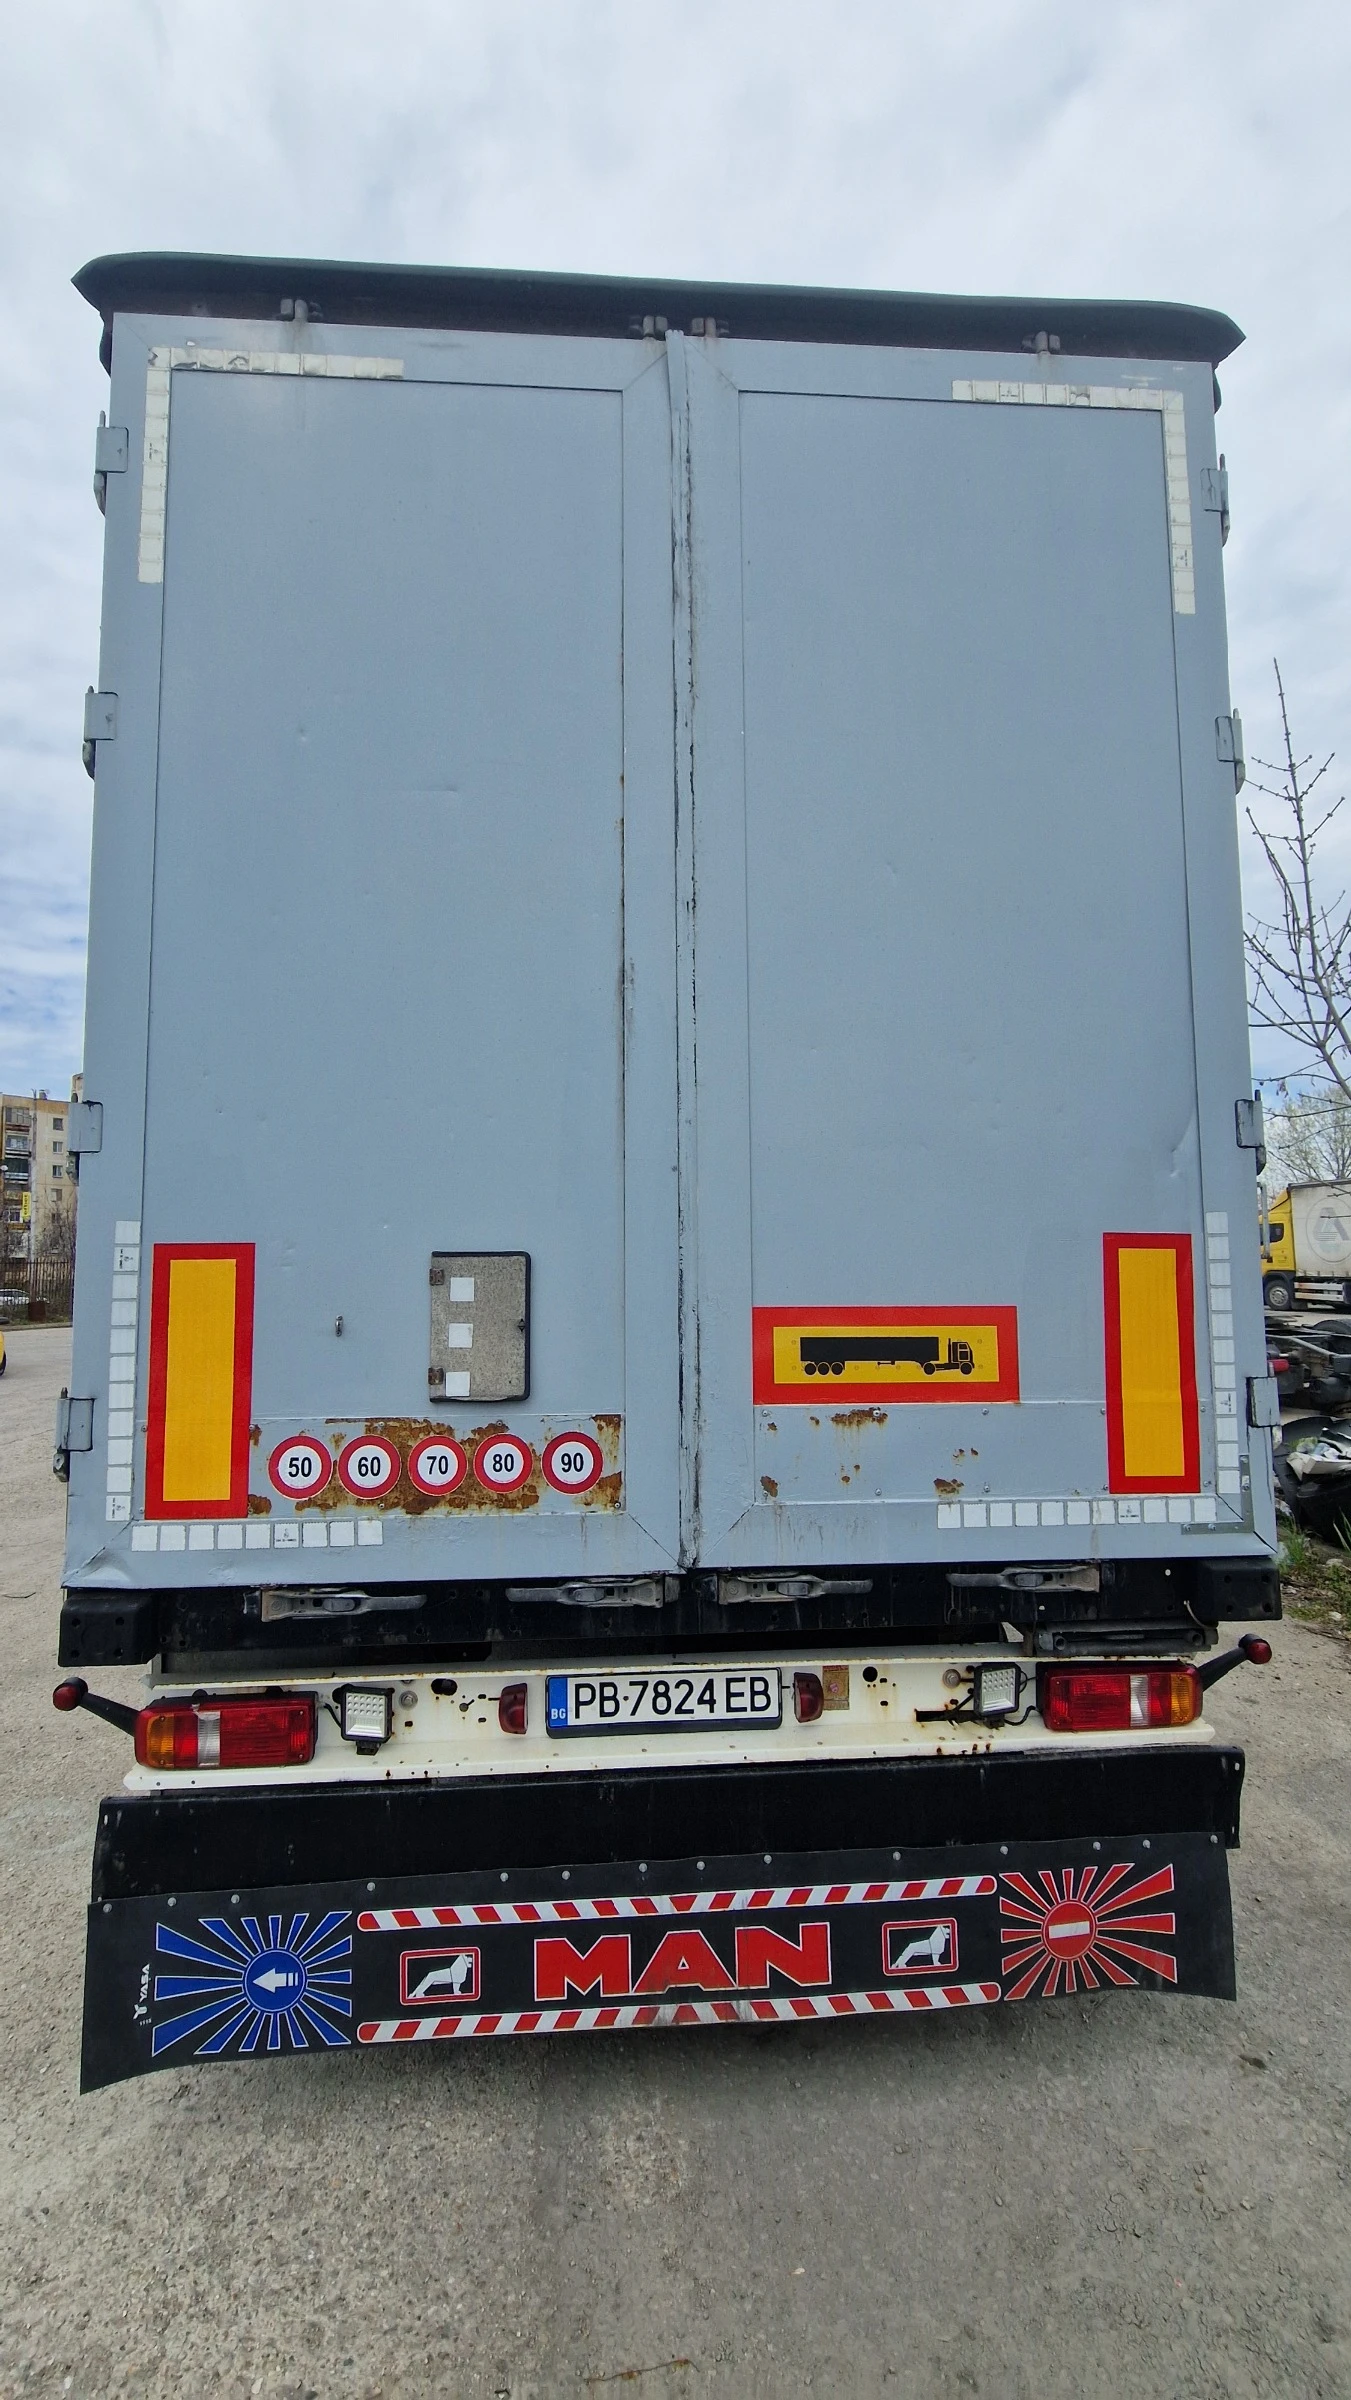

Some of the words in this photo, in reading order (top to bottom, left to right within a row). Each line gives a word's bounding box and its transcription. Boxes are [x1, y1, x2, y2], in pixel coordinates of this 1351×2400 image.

[288, 1456, 312, 1477] 50
[357, 1456, 381, 1477] 60
[426, 1455, 449, 1475] 70
[492, 1452, 514, 1473] 80
[560, 1452, 584, 1473] 90
[551, 1708, 566, 1720] BG
[534, 1922, 832, 2001] MAN
